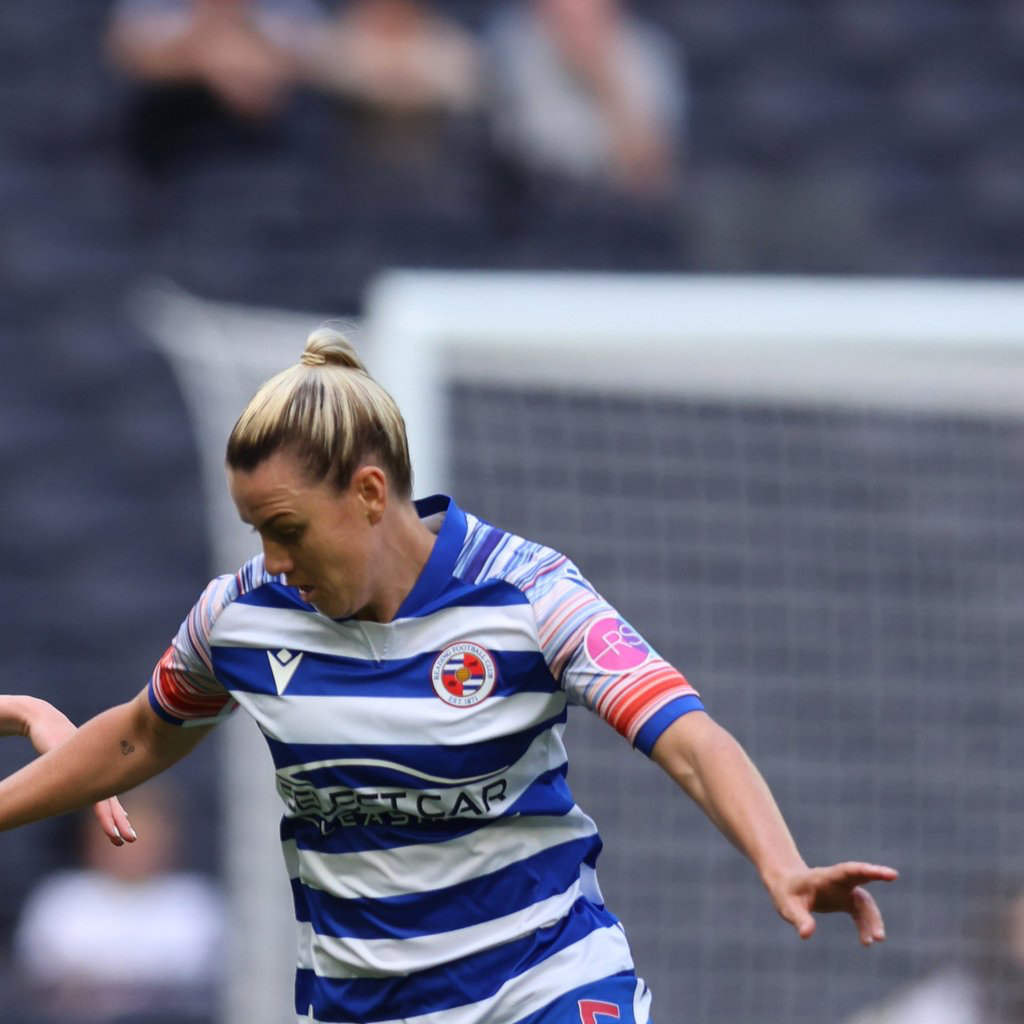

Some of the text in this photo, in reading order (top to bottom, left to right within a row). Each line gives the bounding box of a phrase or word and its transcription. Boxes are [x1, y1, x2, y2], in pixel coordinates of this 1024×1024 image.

[433, 644, 494, 680] READING FOOTBALL CLUB
[416, 778, 508, 819] CAR
